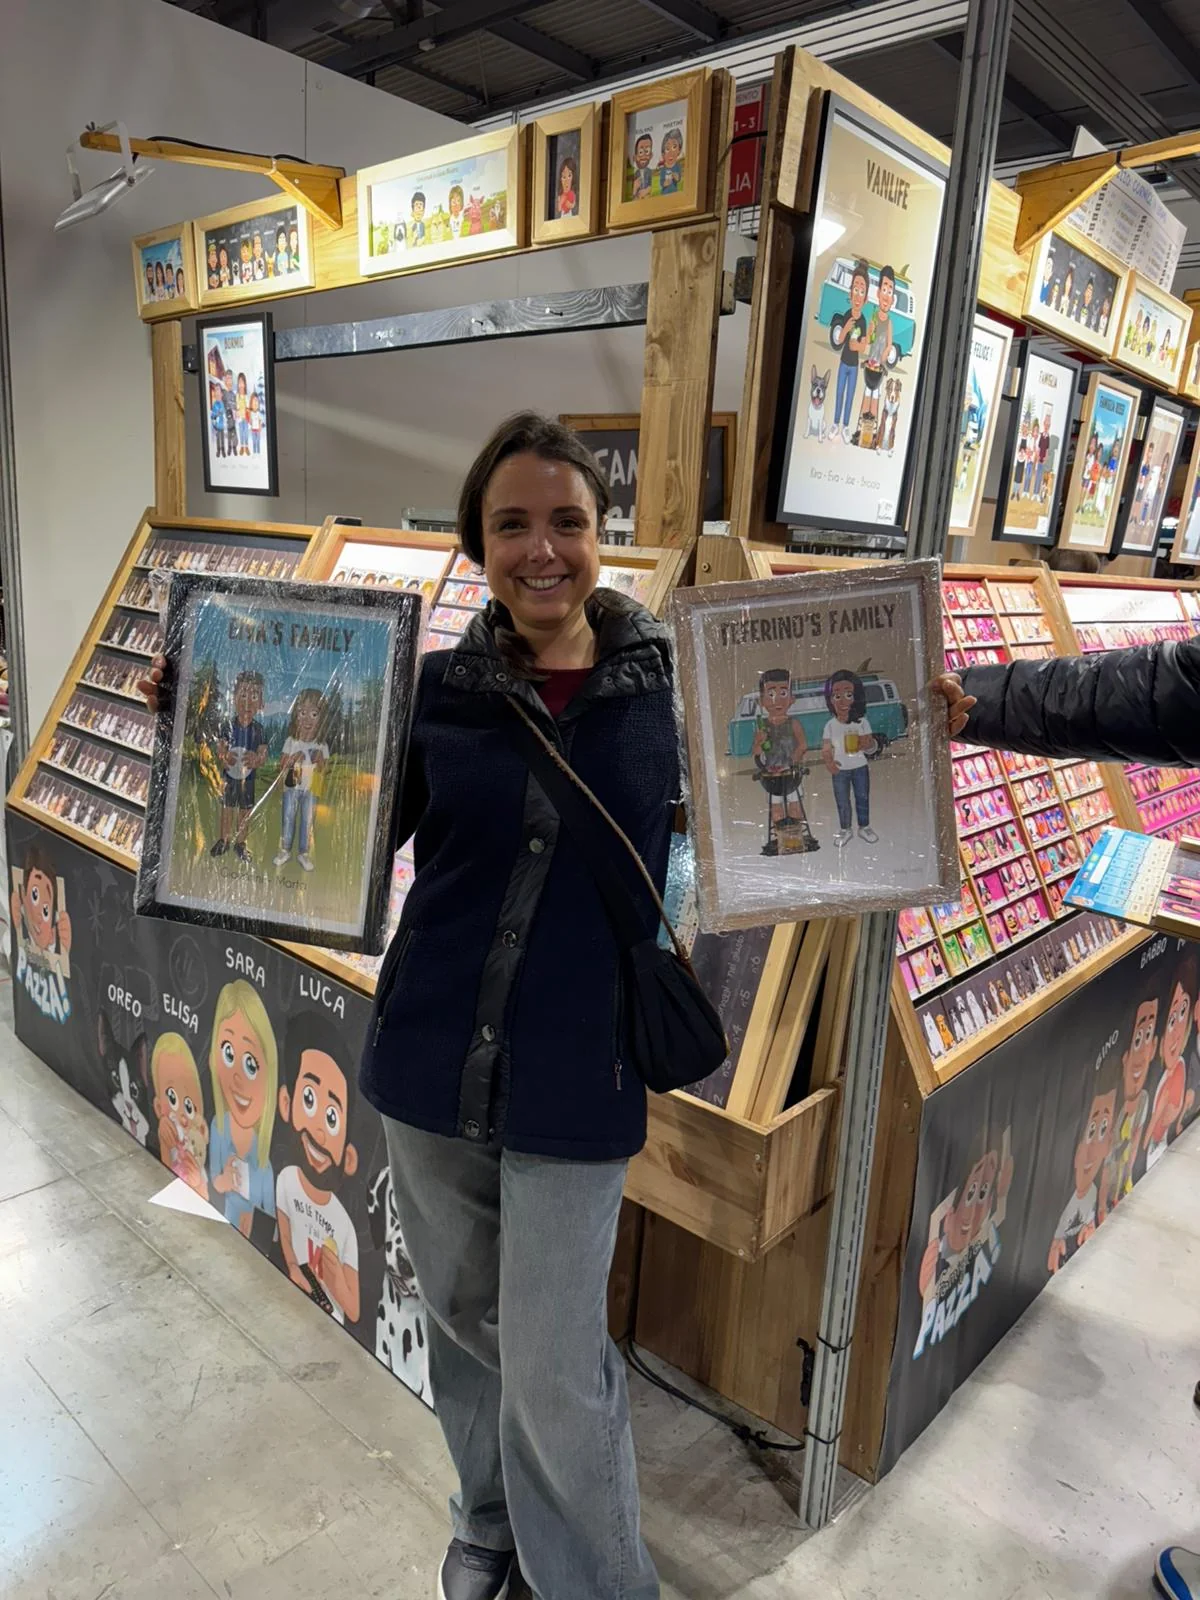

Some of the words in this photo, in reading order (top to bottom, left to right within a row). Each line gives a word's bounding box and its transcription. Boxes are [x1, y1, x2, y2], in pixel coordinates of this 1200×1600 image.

[866, 159, 911, 210] VANLIFE
[290, 623, 356, 653] FAMILY
[829, 604, 896, 635] FAMILY
[276, 875, 309, 891] Marta
[225, 947, 266, 988] SARA
[1140, 937, 1168, 969] BABBO
[15, 945, 73, 1025] PAZZA!
[107, 984, 142, 1018] OREO
[300, 974, 346, 1020] LUCA
[163, 993, 199, 1034] ELISA
[1095, 1029, 1119, 1071] GINO
[293, 1199, 305, 1214] PAS
[305, 1203, 313, 1218] LE
[315, 1210, 336, 1239] TEMPS
[912, 1222, 1001, 1361] PAZZA!
